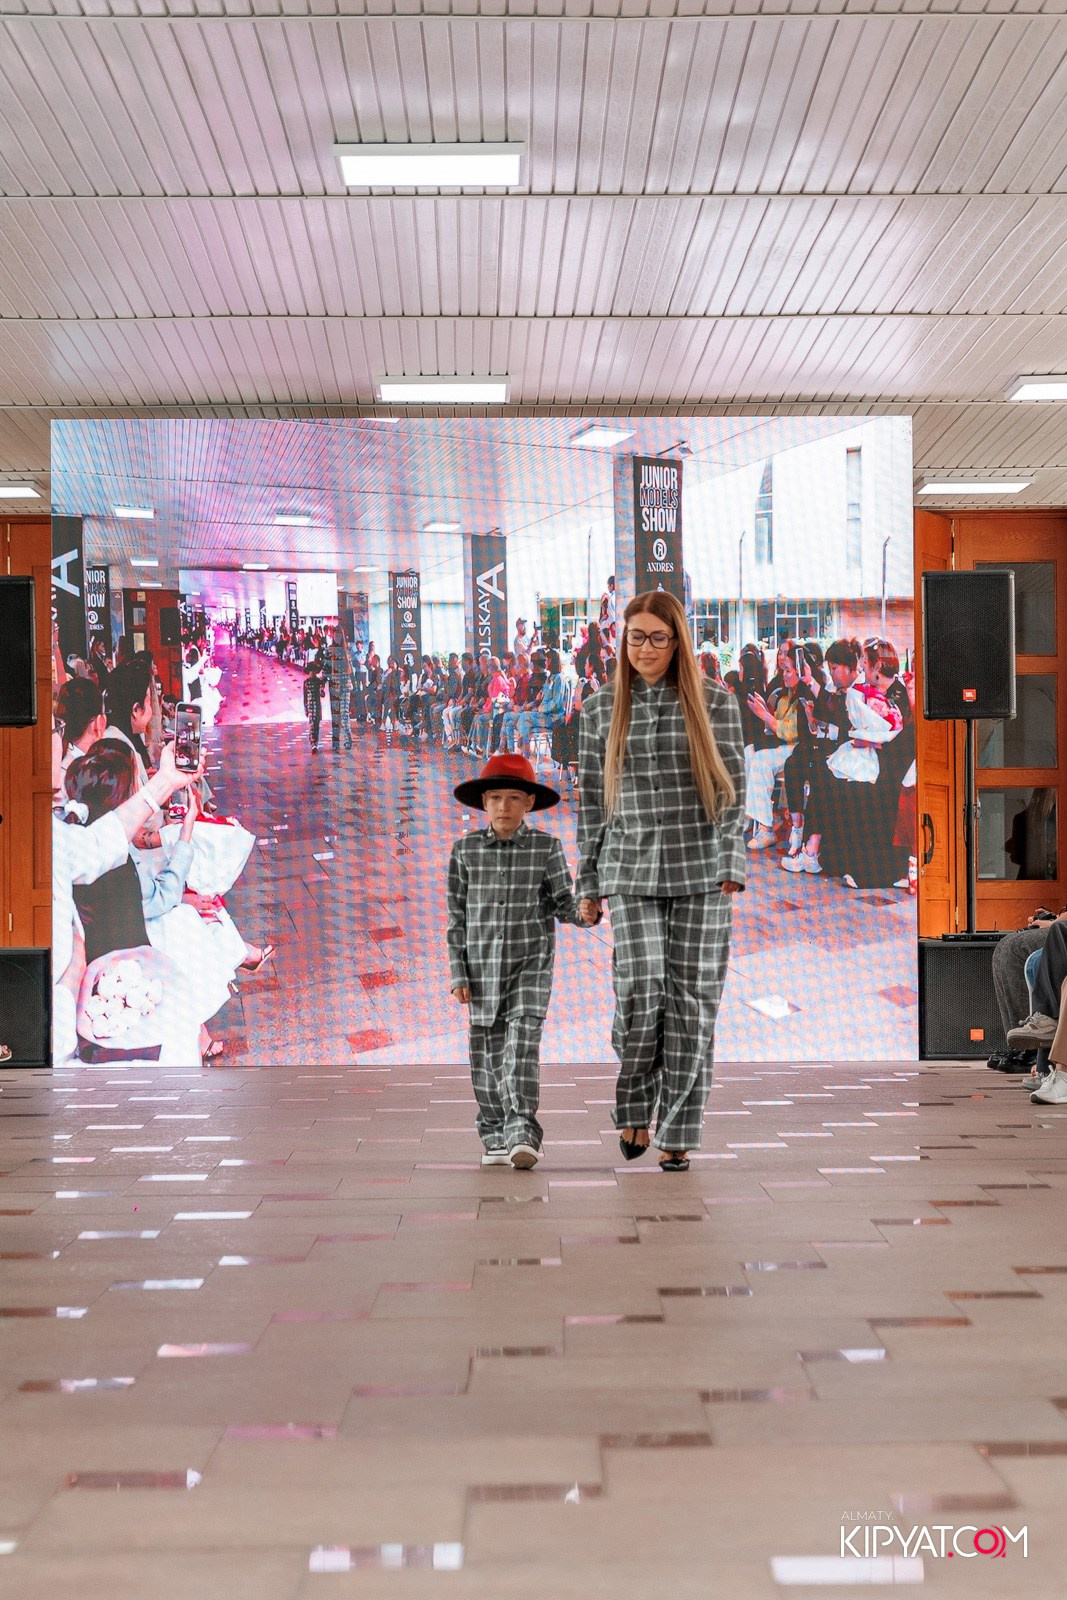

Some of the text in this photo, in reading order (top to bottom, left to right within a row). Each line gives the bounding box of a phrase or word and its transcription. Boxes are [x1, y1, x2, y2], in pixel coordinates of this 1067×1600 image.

[640, 465, 678, 489] JUNIOR
[640, 487, 679, 509] MODELS
[641, 507, 677, 533] SHOW
[646, 562, 675, 573] ANDRES
[396, 576, 418, 588] JUNIOR
[397, 596, 418, 609] SHOW
